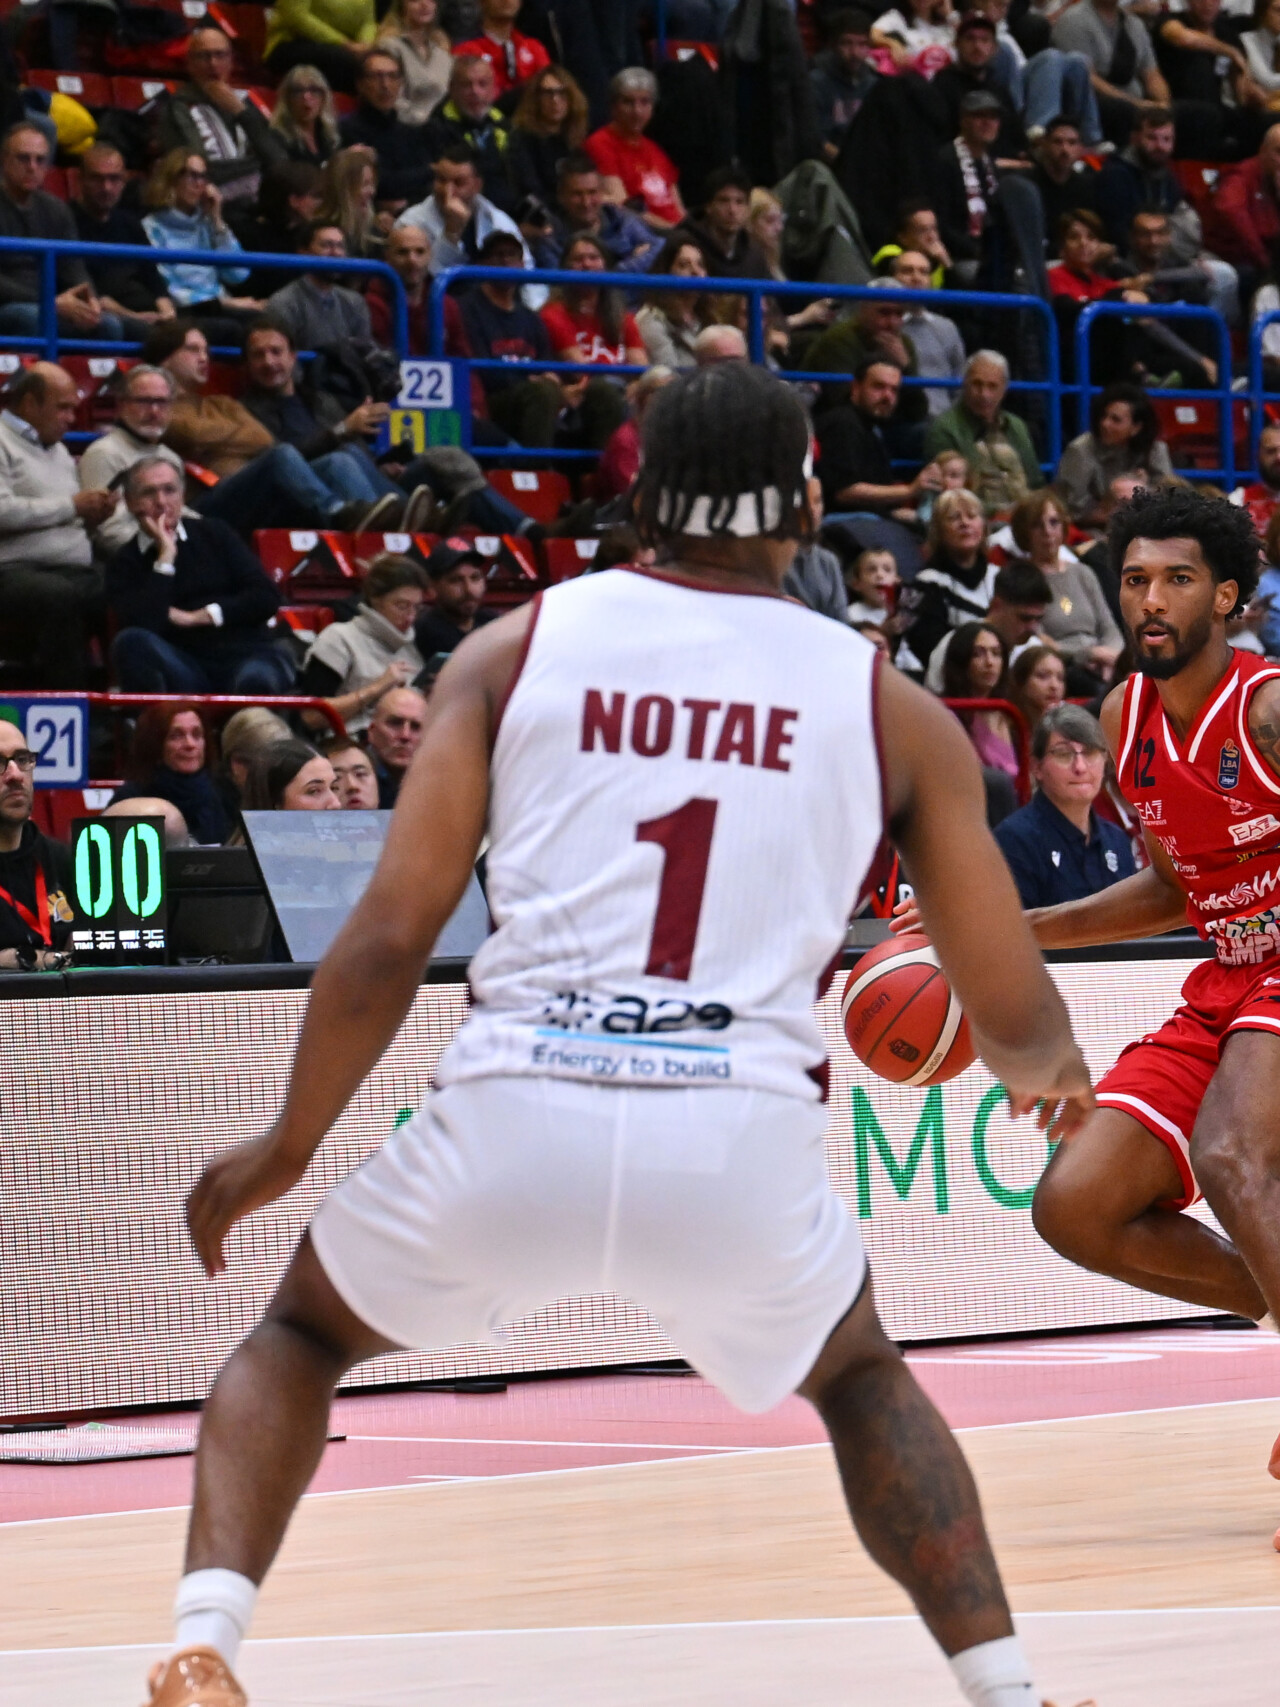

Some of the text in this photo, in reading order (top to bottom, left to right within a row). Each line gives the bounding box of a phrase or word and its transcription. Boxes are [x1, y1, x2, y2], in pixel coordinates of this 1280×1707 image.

[406, 367, 443, 400] 22
[34, 717, 75, 767] 21
[580, 687, 800, 773] NOTAE
[1222, 759, 1238, 769] LBA
[1232, 817, 1271, 841] EA7
[634, 796, 718, 982] 1
[602, 995, 733, 1034] a29
[531, 1043, 731, 1079] Energy to build
